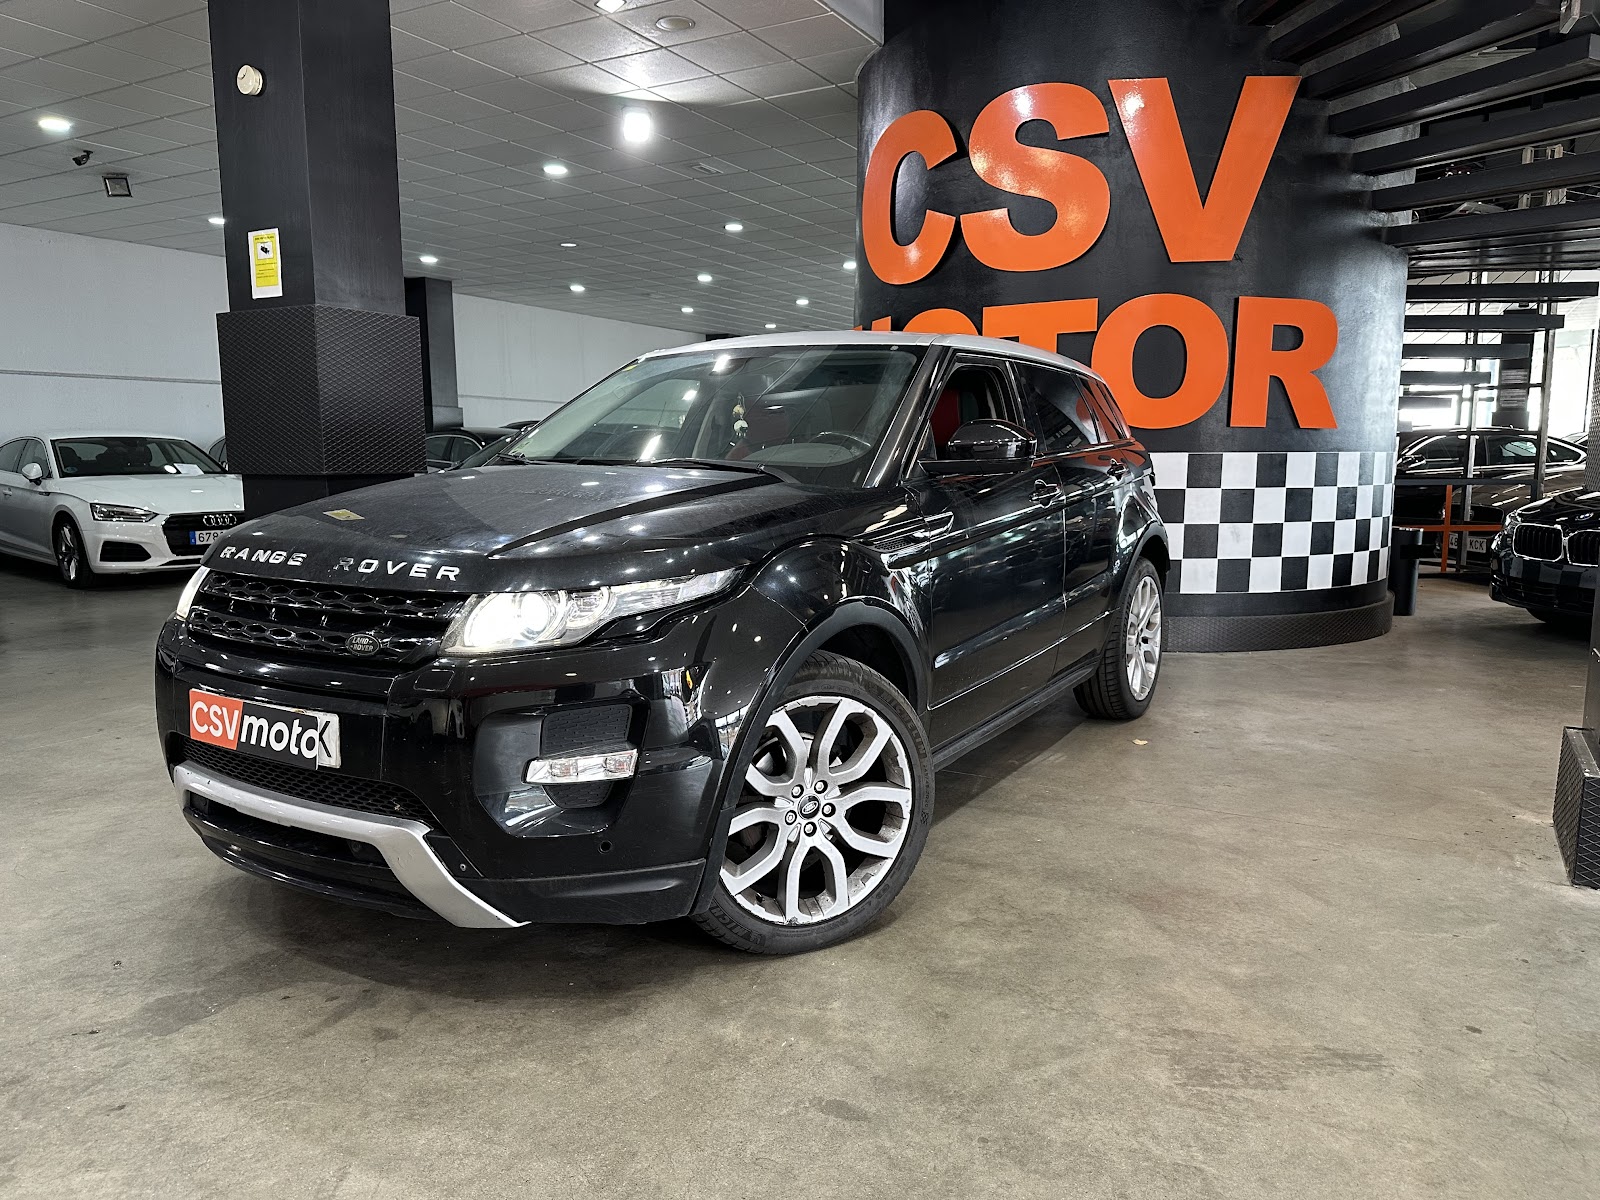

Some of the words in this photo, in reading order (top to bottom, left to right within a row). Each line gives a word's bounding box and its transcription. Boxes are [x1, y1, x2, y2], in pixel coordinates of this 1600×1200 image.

[862, 76, 1302, 285] CSV
[198, 532, 223, 543] 678
[1469, 538, 1485, 551] KCK
[220, 545, 307, 567] RANGE
[333, 556, 460, 582] ROVER
